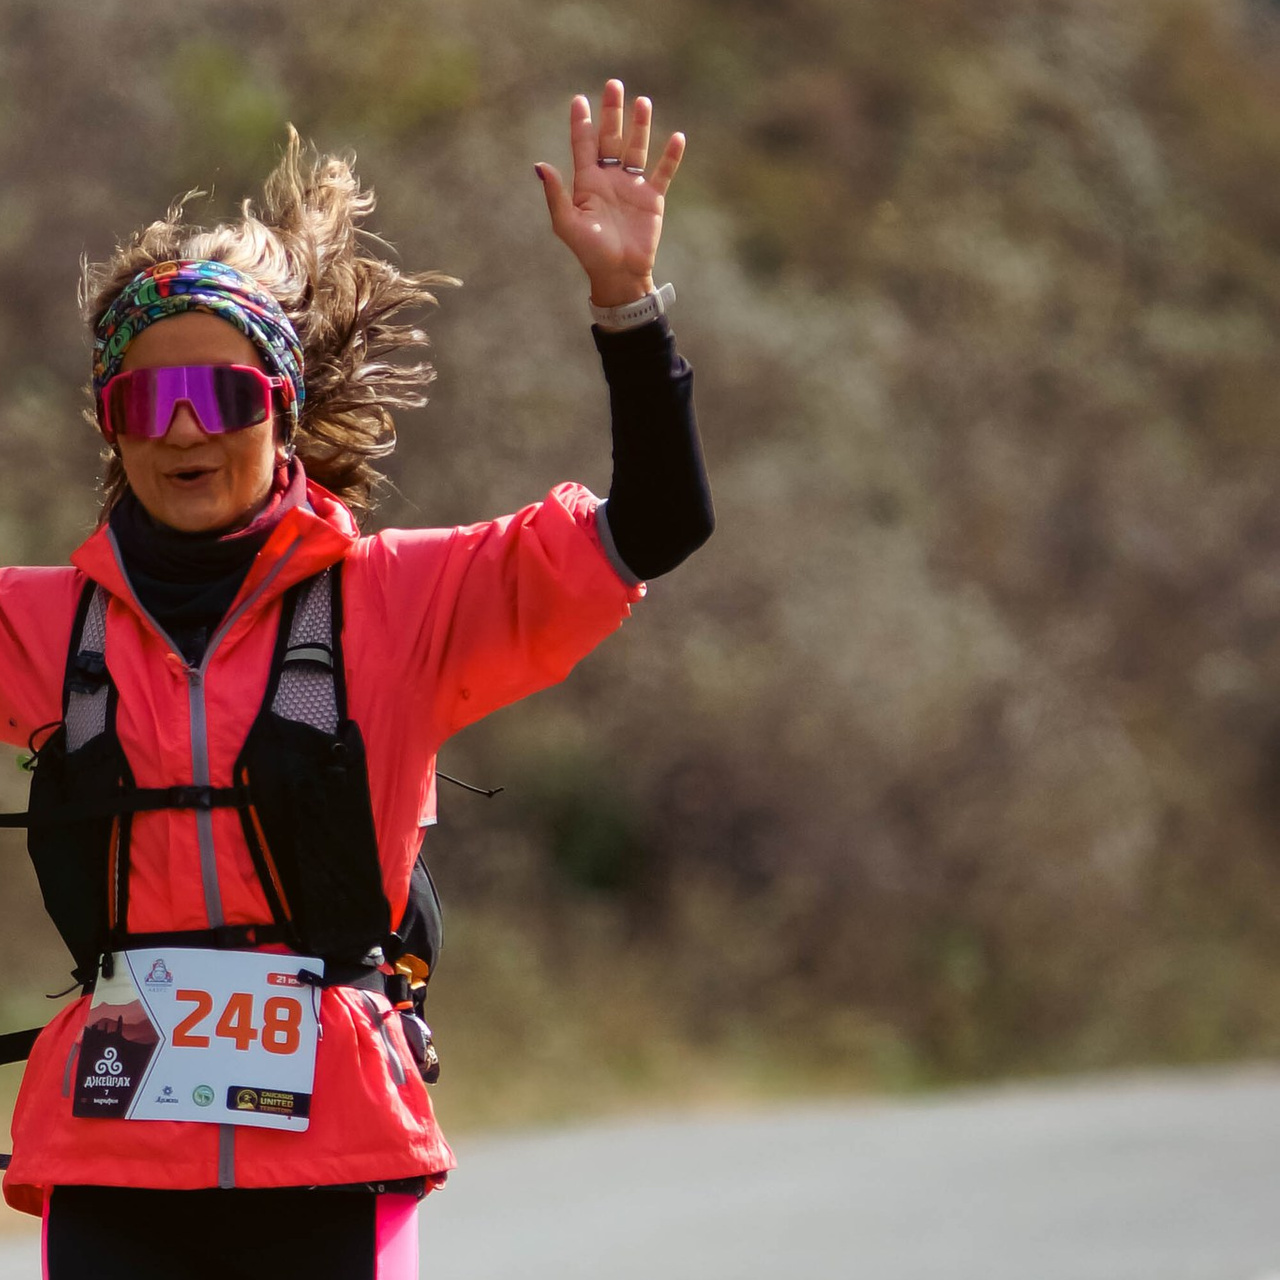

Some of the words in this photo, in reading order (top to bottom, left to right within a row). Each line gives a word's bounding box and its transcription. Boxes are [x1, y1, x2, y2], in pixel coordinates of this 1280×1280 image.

[276, 975, 286, 984] 21
[172, 989, 302, 1055] 248
[84, 1075, 130, 1088] ДЖЕЙРАХ
[260, 1097, 294, 1108] UNITED
